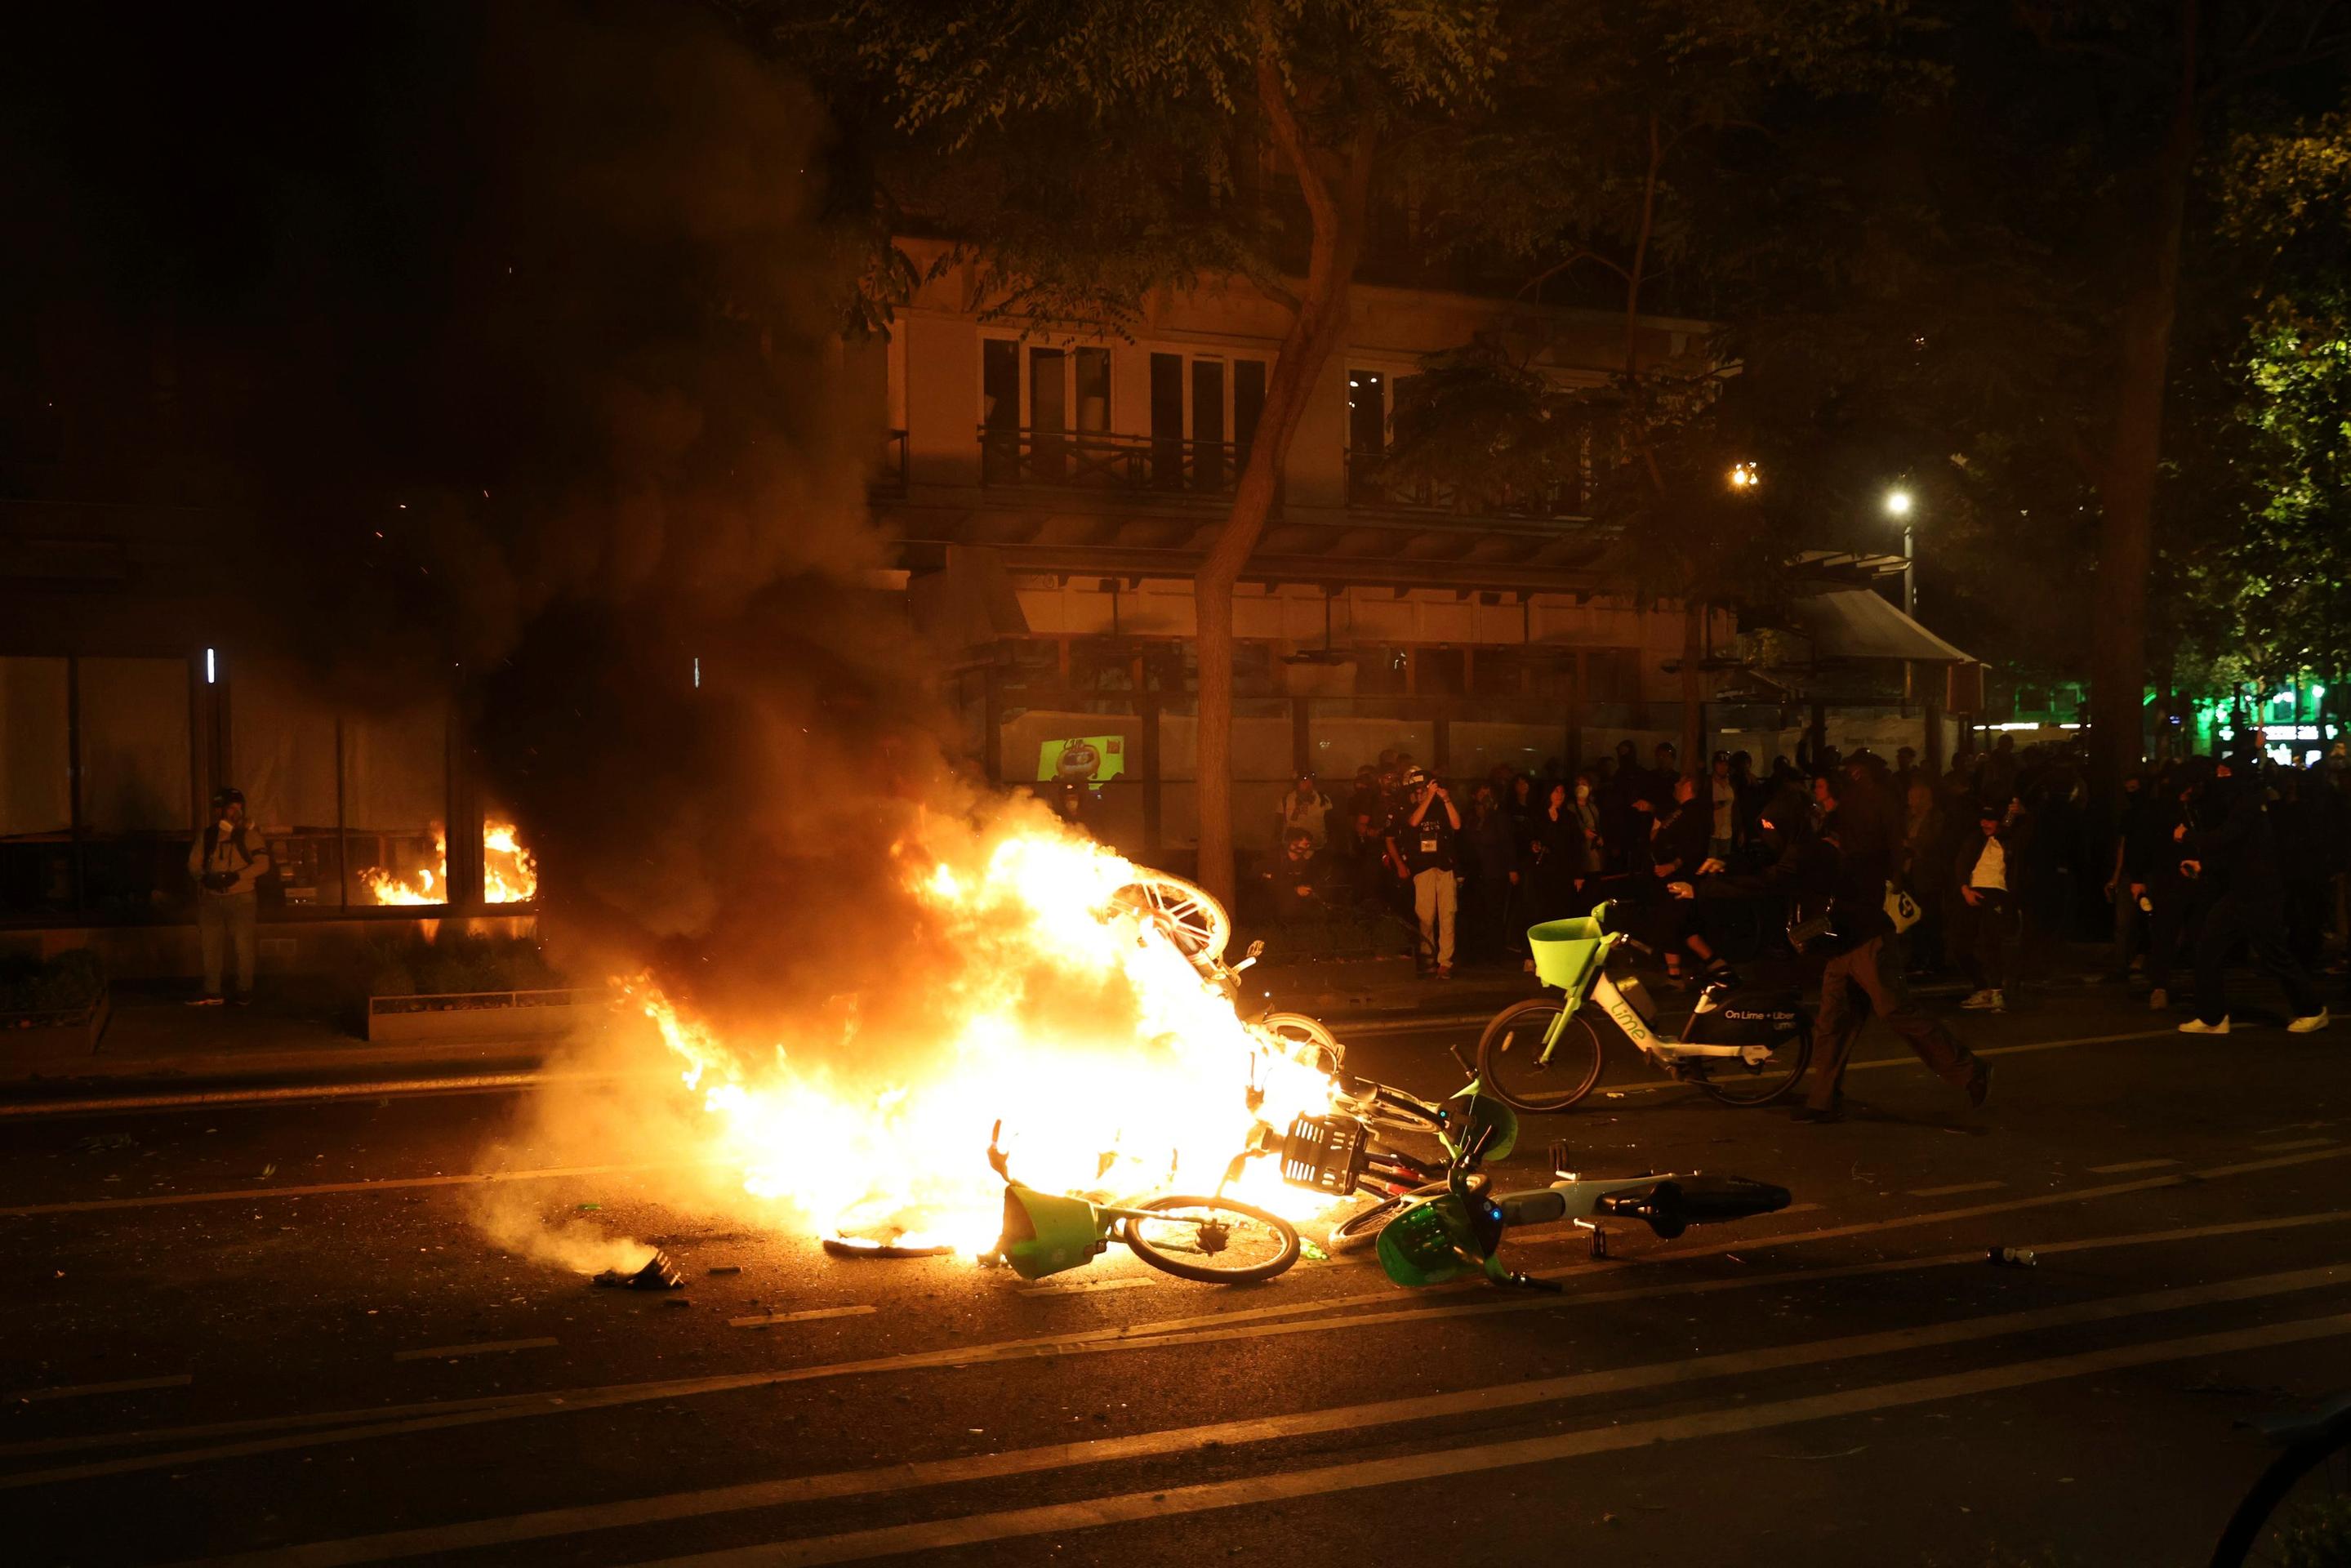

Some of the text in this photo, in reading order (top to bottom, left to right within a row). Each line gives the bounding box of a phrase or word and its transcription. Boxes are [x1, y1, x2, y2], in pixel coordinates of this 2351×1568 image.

[1725, 1009, 1740, 1019] On
[1741, 1011, 1764, 1019] Lime
[1773, 1012, 1795, 1020] Uber
